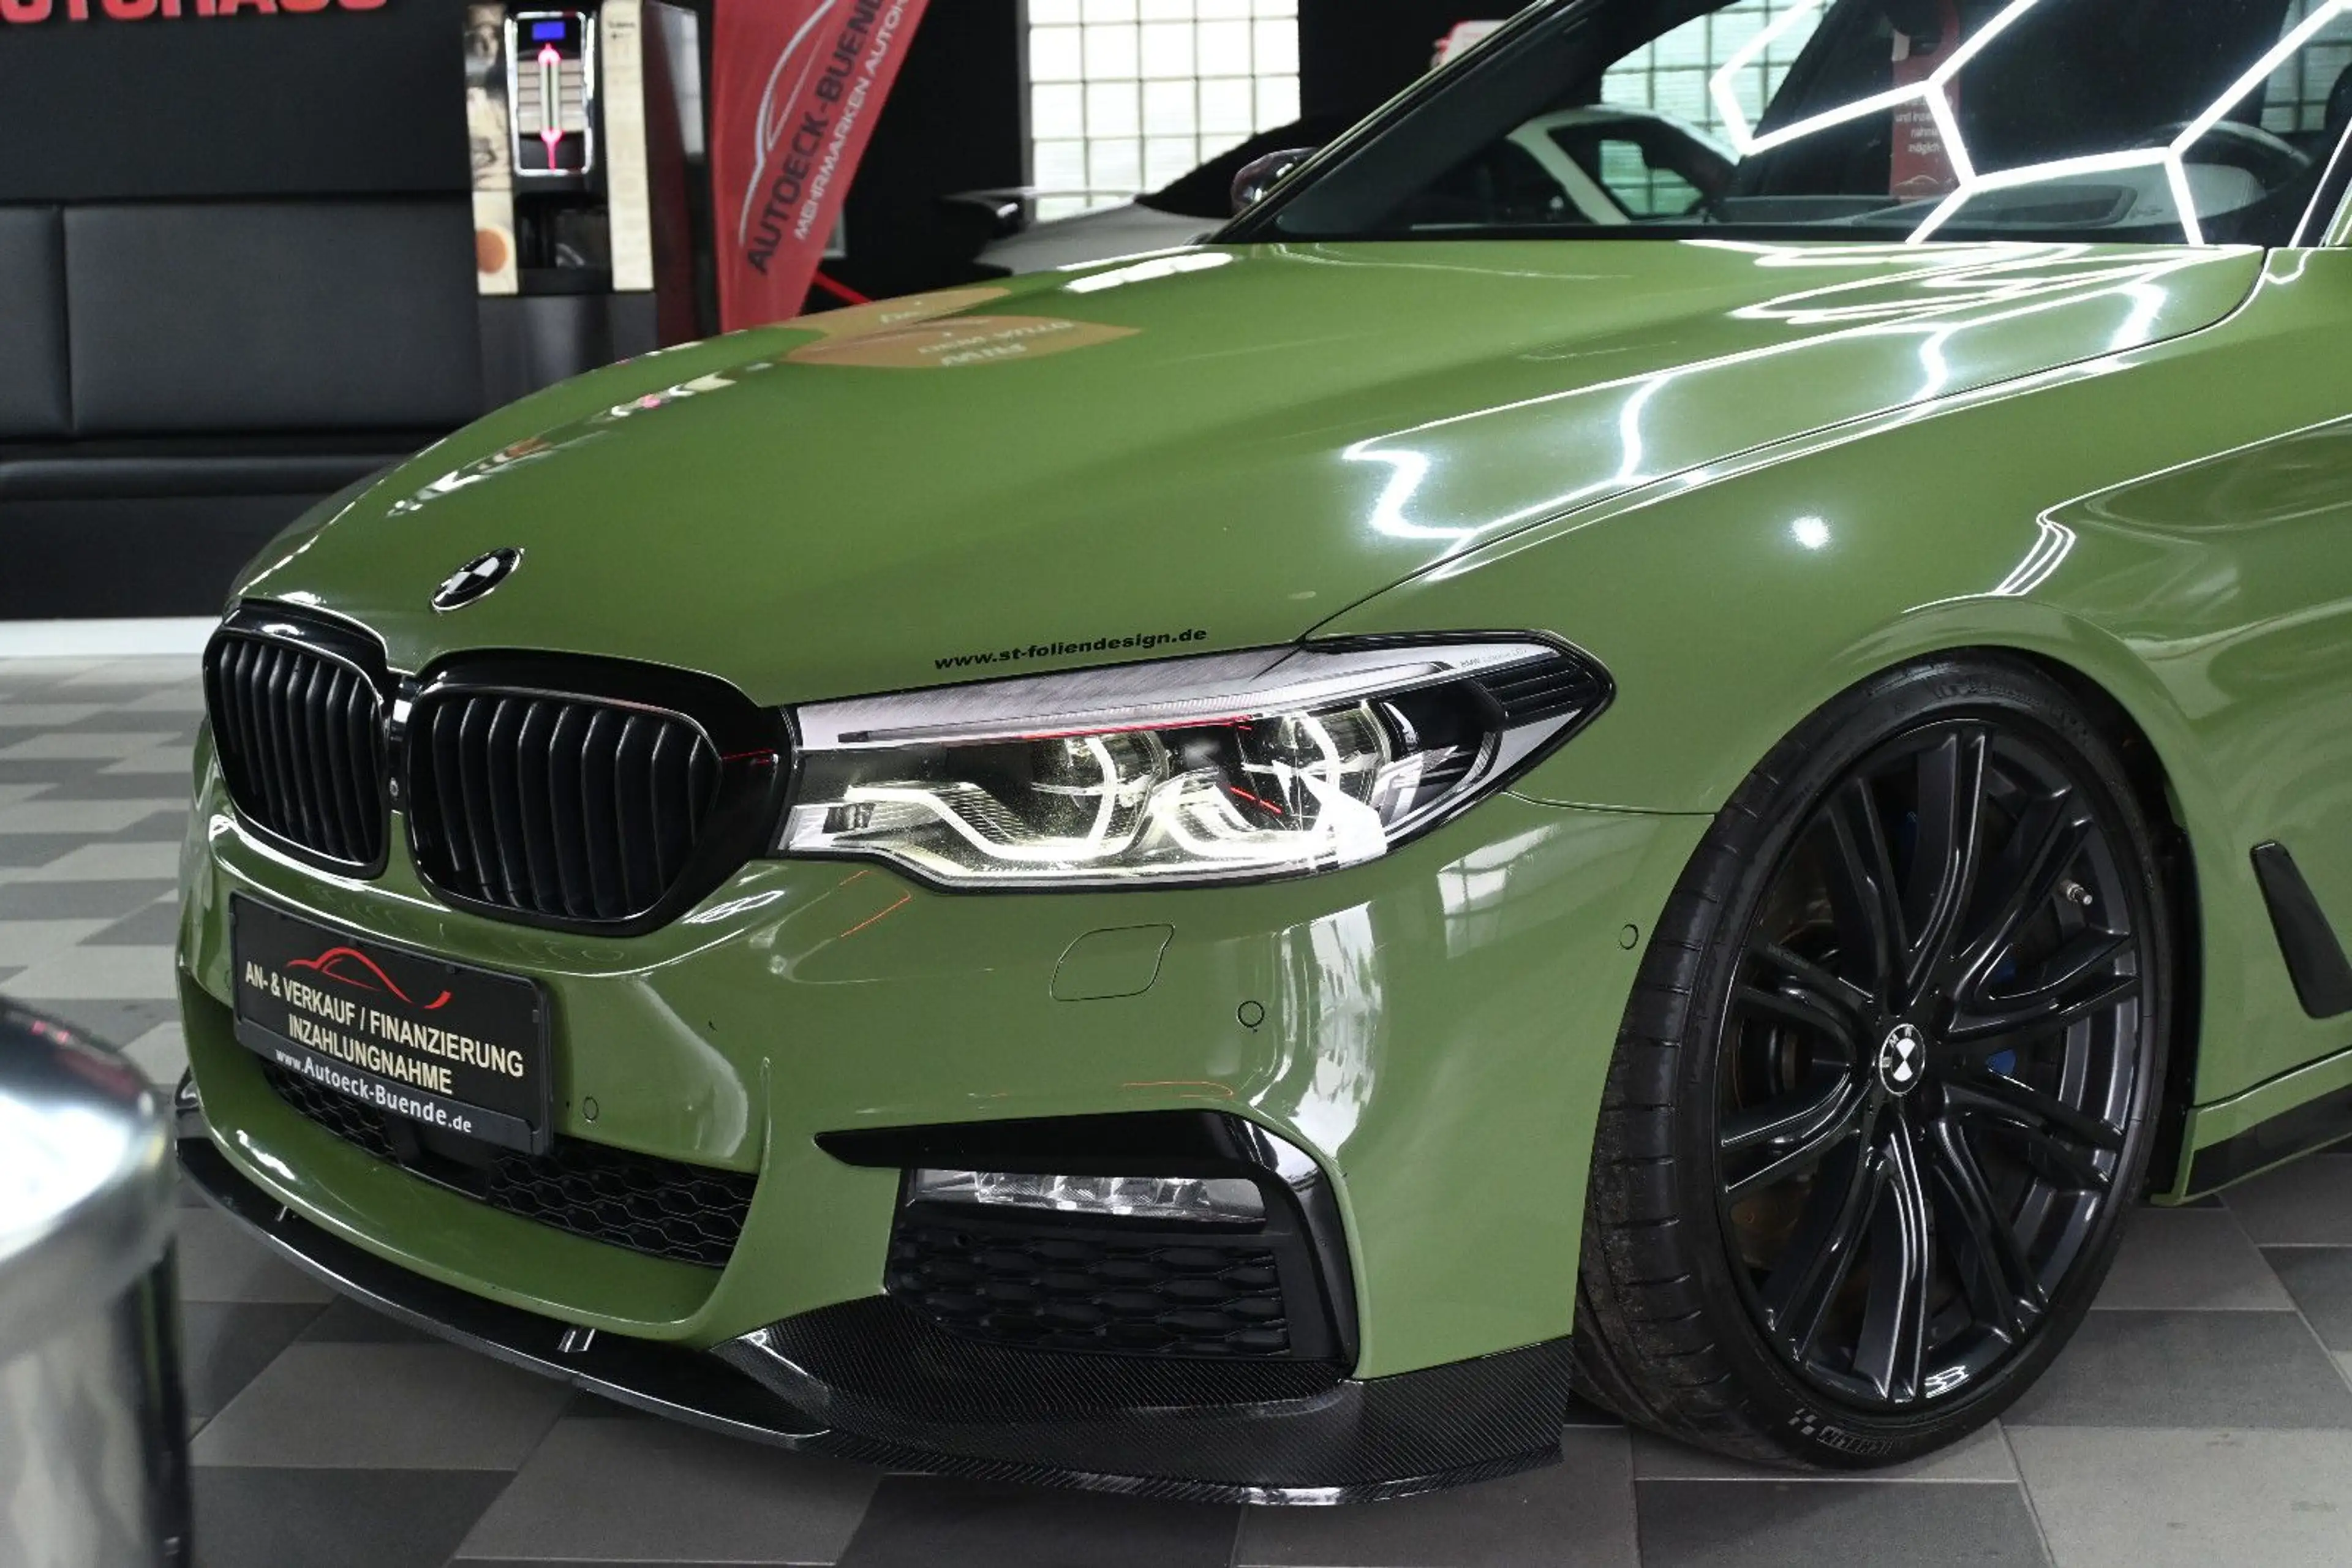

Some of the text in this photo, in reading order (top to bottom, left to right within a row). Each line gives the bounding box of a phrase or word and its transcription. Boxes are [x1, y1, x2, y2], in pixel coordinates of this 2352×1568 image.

[794, 77, 872, 241] MEHRMARKEN
[934, 629, 1207, 669] www.st-foliendesign.de
[246, 960, 524, 1077] AN- & VERKAUF / FINANZIERUNG
[288, 1013, 453, 1095] INZAHLUNGNAHME
[275, 1049, 472, 1133] www.Autoeck-Buende.de
